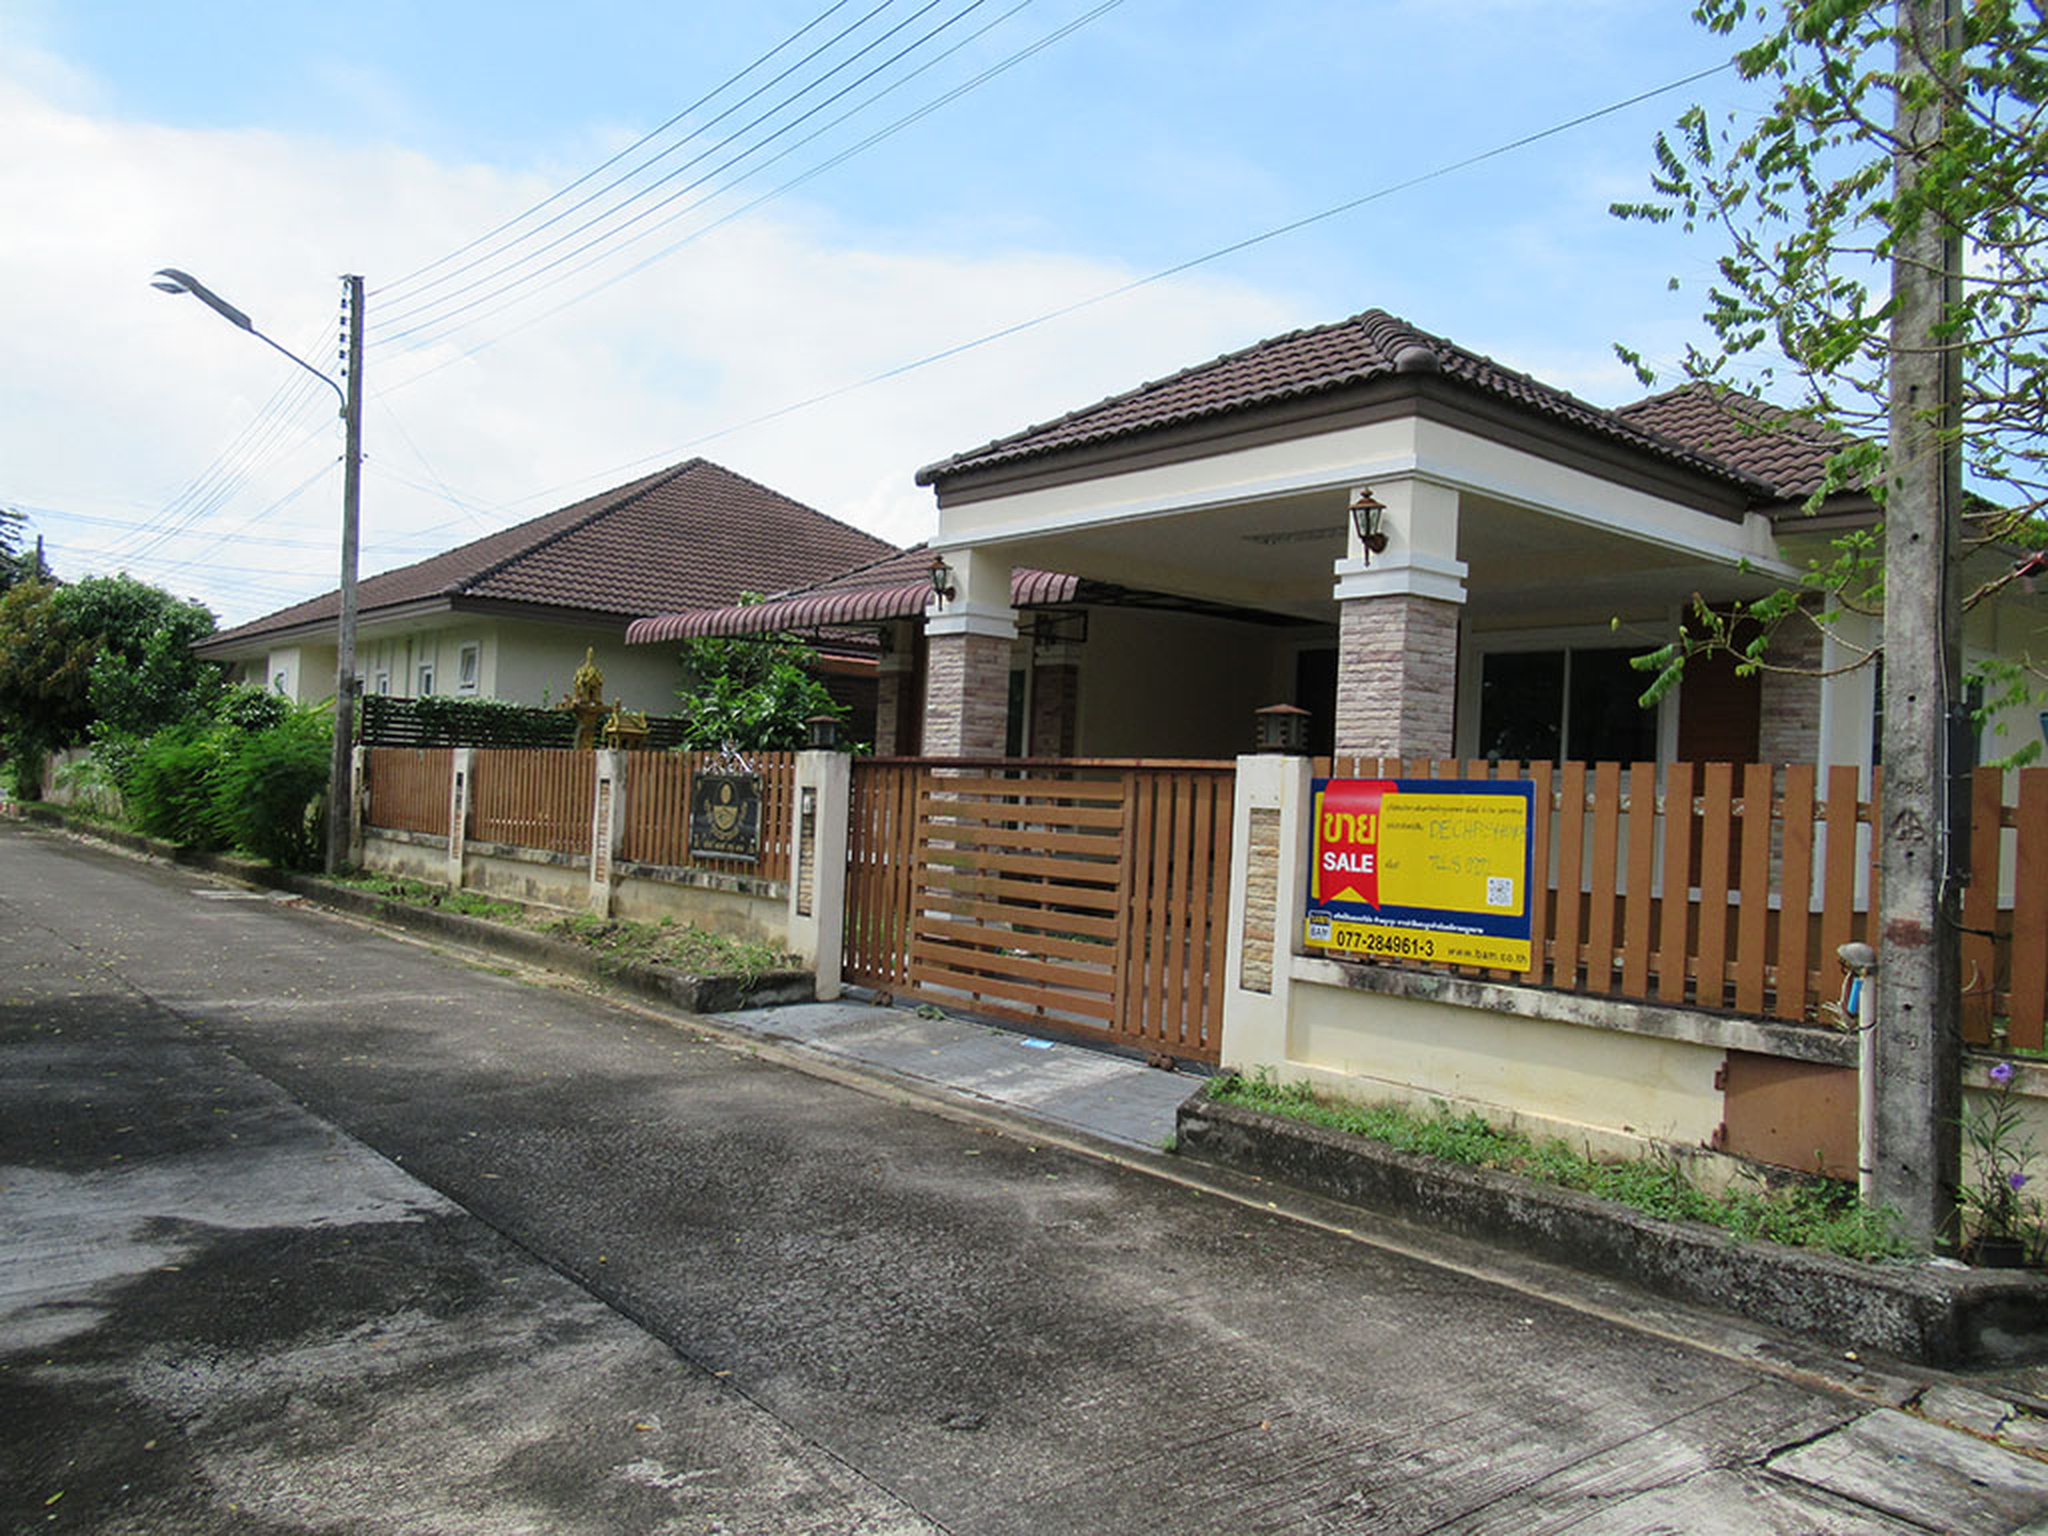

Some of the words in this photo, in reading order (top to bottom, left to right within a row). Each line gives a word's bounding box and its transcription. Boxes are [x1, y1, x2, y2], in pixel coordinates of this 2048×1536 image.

[1324, 812, 1376, 844] ขาย
[1323, 851, 1374, 873] SALE
[1337, 931, 1434, 957] 077-284961-3
[1448, 947, 1527, 963] www.bam.co.th
